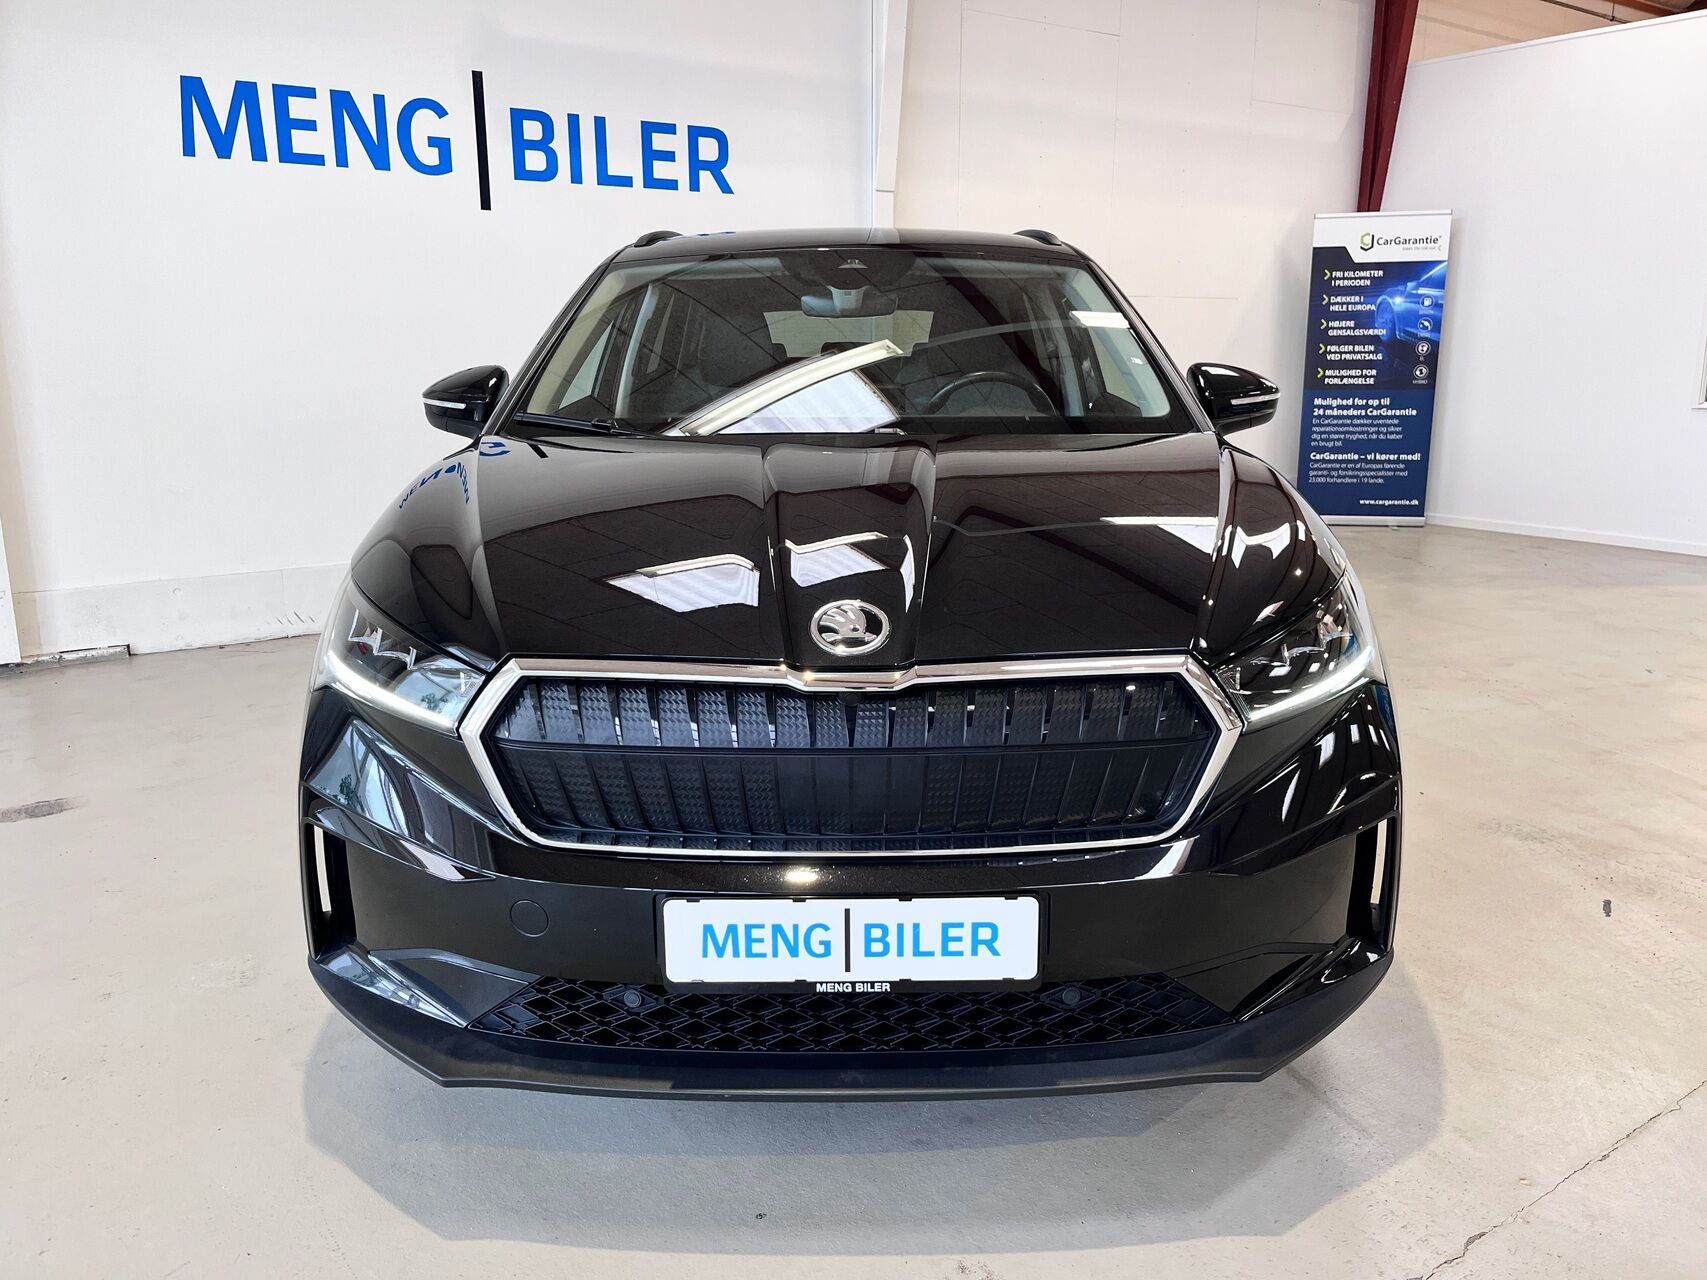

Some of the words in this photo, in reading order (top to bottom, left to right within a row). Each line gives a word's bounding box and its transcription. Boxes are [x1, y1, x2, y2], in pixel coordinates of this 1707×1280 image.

[180, 75, 453, 176] MENG
[509, 107, 734, 195] BILER
[1376, 235, 1439, 246] CarGarantie
[1344, 270, 1384, 278] KILOMETER
[1314, 398, 1352, 406] Mulighed
[1354, 398, 1366, 406] for
[1380, 398, 1390, 406] til
[1325, 408, 1366, 416] måneders
[1366, 408, 1417, 416] CarGarantie
[701, 922, 832, 959] MENG
[864, 922, 1001, 958] BILER
[816, 983, 852, 992] MENG
[855, 982, 890, 992] BILER
